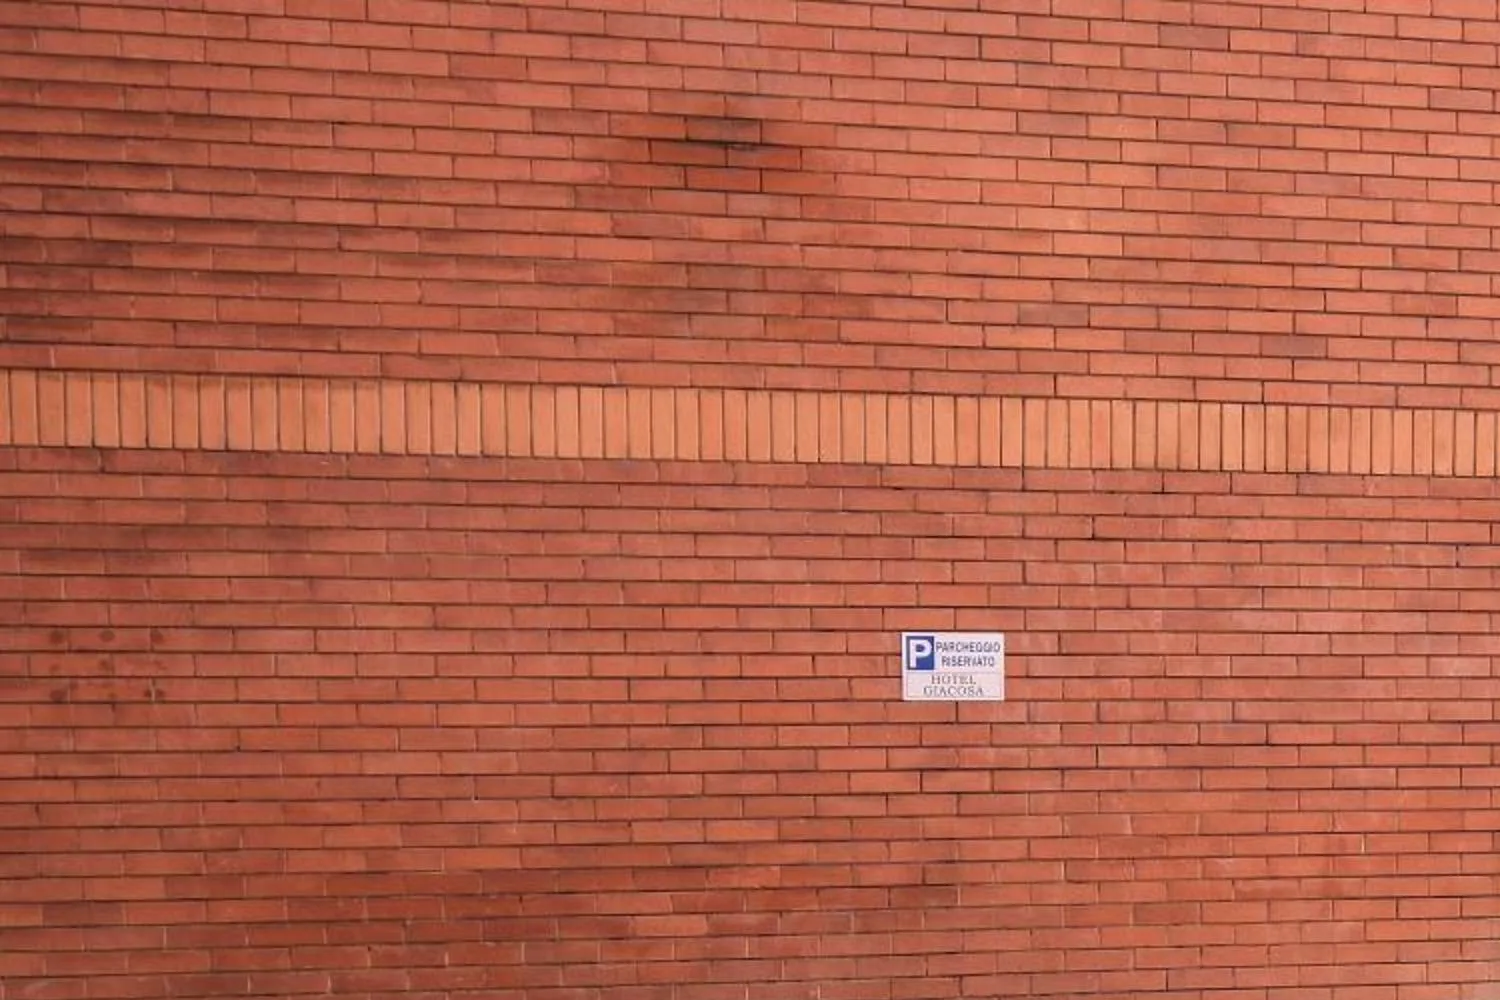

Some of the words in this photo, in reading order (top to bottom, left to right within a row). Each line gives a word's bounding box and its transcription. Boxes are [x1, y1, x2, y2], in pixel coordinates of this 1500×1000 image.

[936, 641, 1001, 653] PARCHEGGIO
[909, 639, 932, 668] P
[941, 656, 995, 667] RISERVATO
[931, 675, 976, 685] HOTEL
[923, 685, 984, 697] GIACOSA
